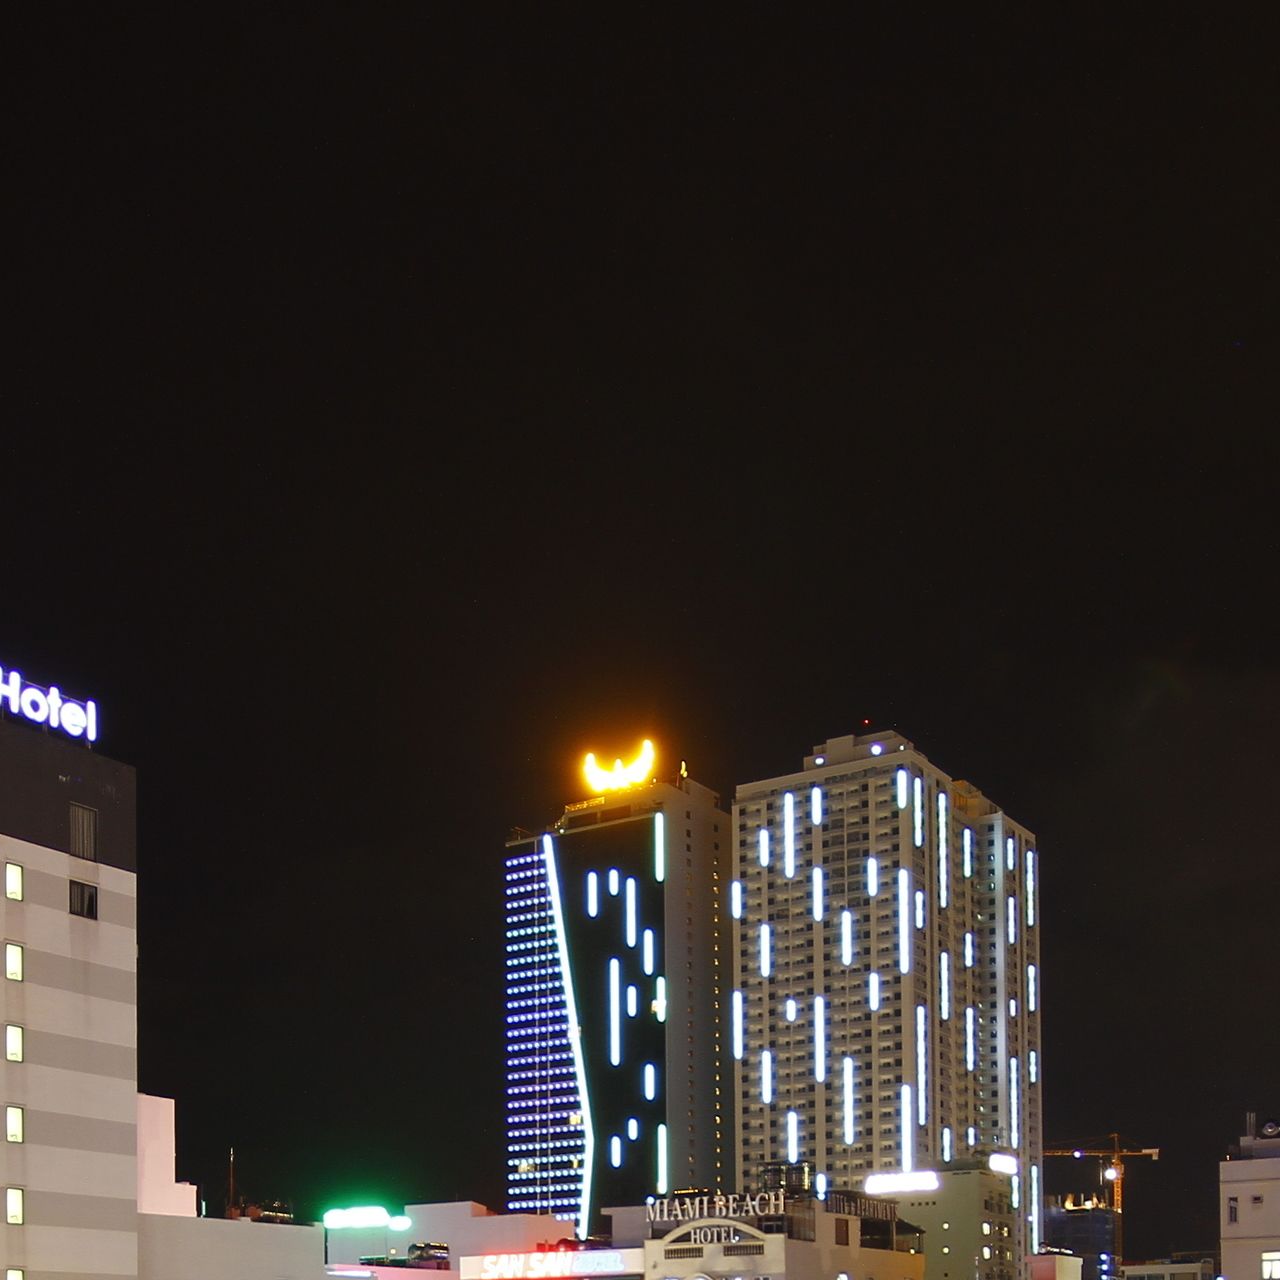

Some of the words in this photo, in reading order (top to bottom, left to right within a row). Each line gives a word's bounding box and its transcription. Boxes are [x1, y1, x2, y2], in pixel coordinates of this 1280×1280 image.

[646, 1196, 708, 1222] MIAMI
[714, 1191, 786, 1218] BEACH
[690, 1227, 739, 1245] HOTEL
[480, 1254, 525, 1280] SAN
[526, 1251, 574, 1279] SAN
